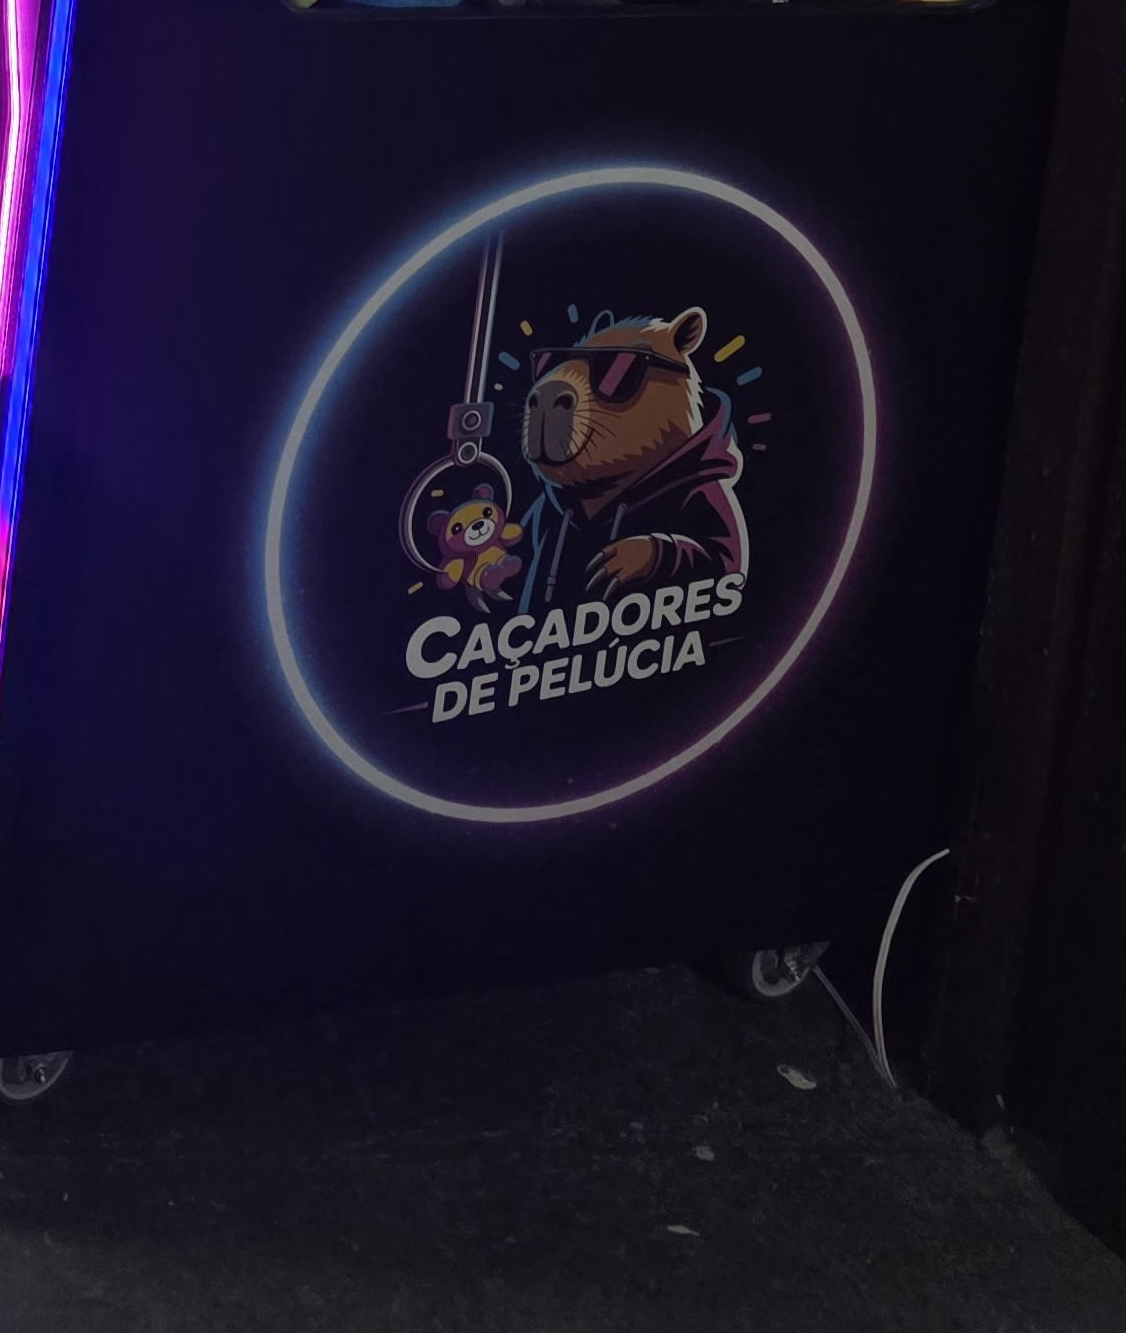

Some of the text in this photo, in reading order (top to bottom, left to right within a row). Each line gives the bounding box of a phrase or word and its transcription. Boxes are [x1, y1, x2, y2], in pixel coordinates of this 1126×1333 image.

[405, 572, 747, 679] CAÇADORES
[431, 630, 706, 724] DE PELÚCIA
